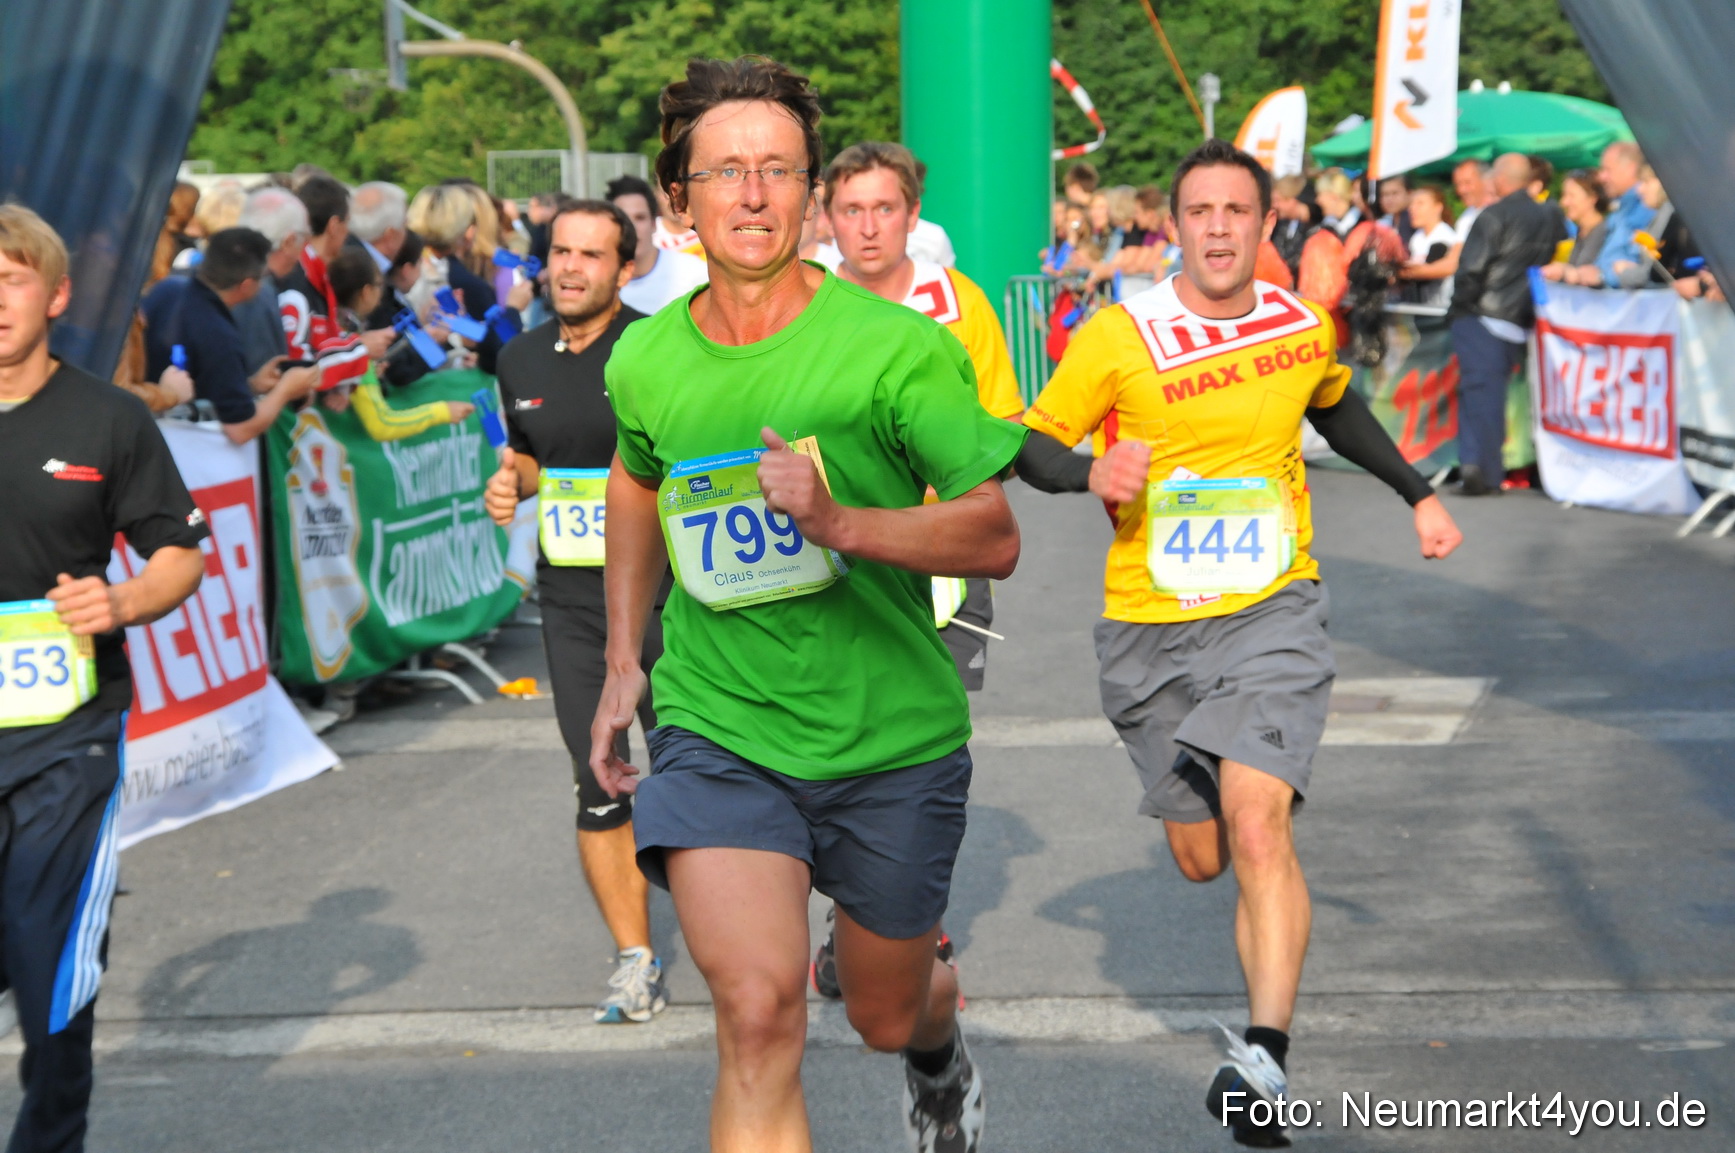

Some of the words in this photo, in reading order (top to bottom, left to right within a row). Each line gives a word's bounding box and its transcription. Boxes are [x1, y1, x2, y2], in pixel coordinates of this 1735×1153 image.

[1162, 363, 1246, 405] MAX
[1253, 340, 1329, 378] BÖGL
[1543, 333, 1669, 450] MEIER
[681, 484, 734, 505] firmenlauf
[545, 505, 605, 538] 135
[682, 505, 804, 573] 799
[1164, 518, 1265, 563] 444
[714, 570, 754, 587] Claus
[758, 565, 801, 578] Ochsenkühn
[735, 584, 760, 594] Klinikum
[761, 579, 788, 589] Neumarkt
